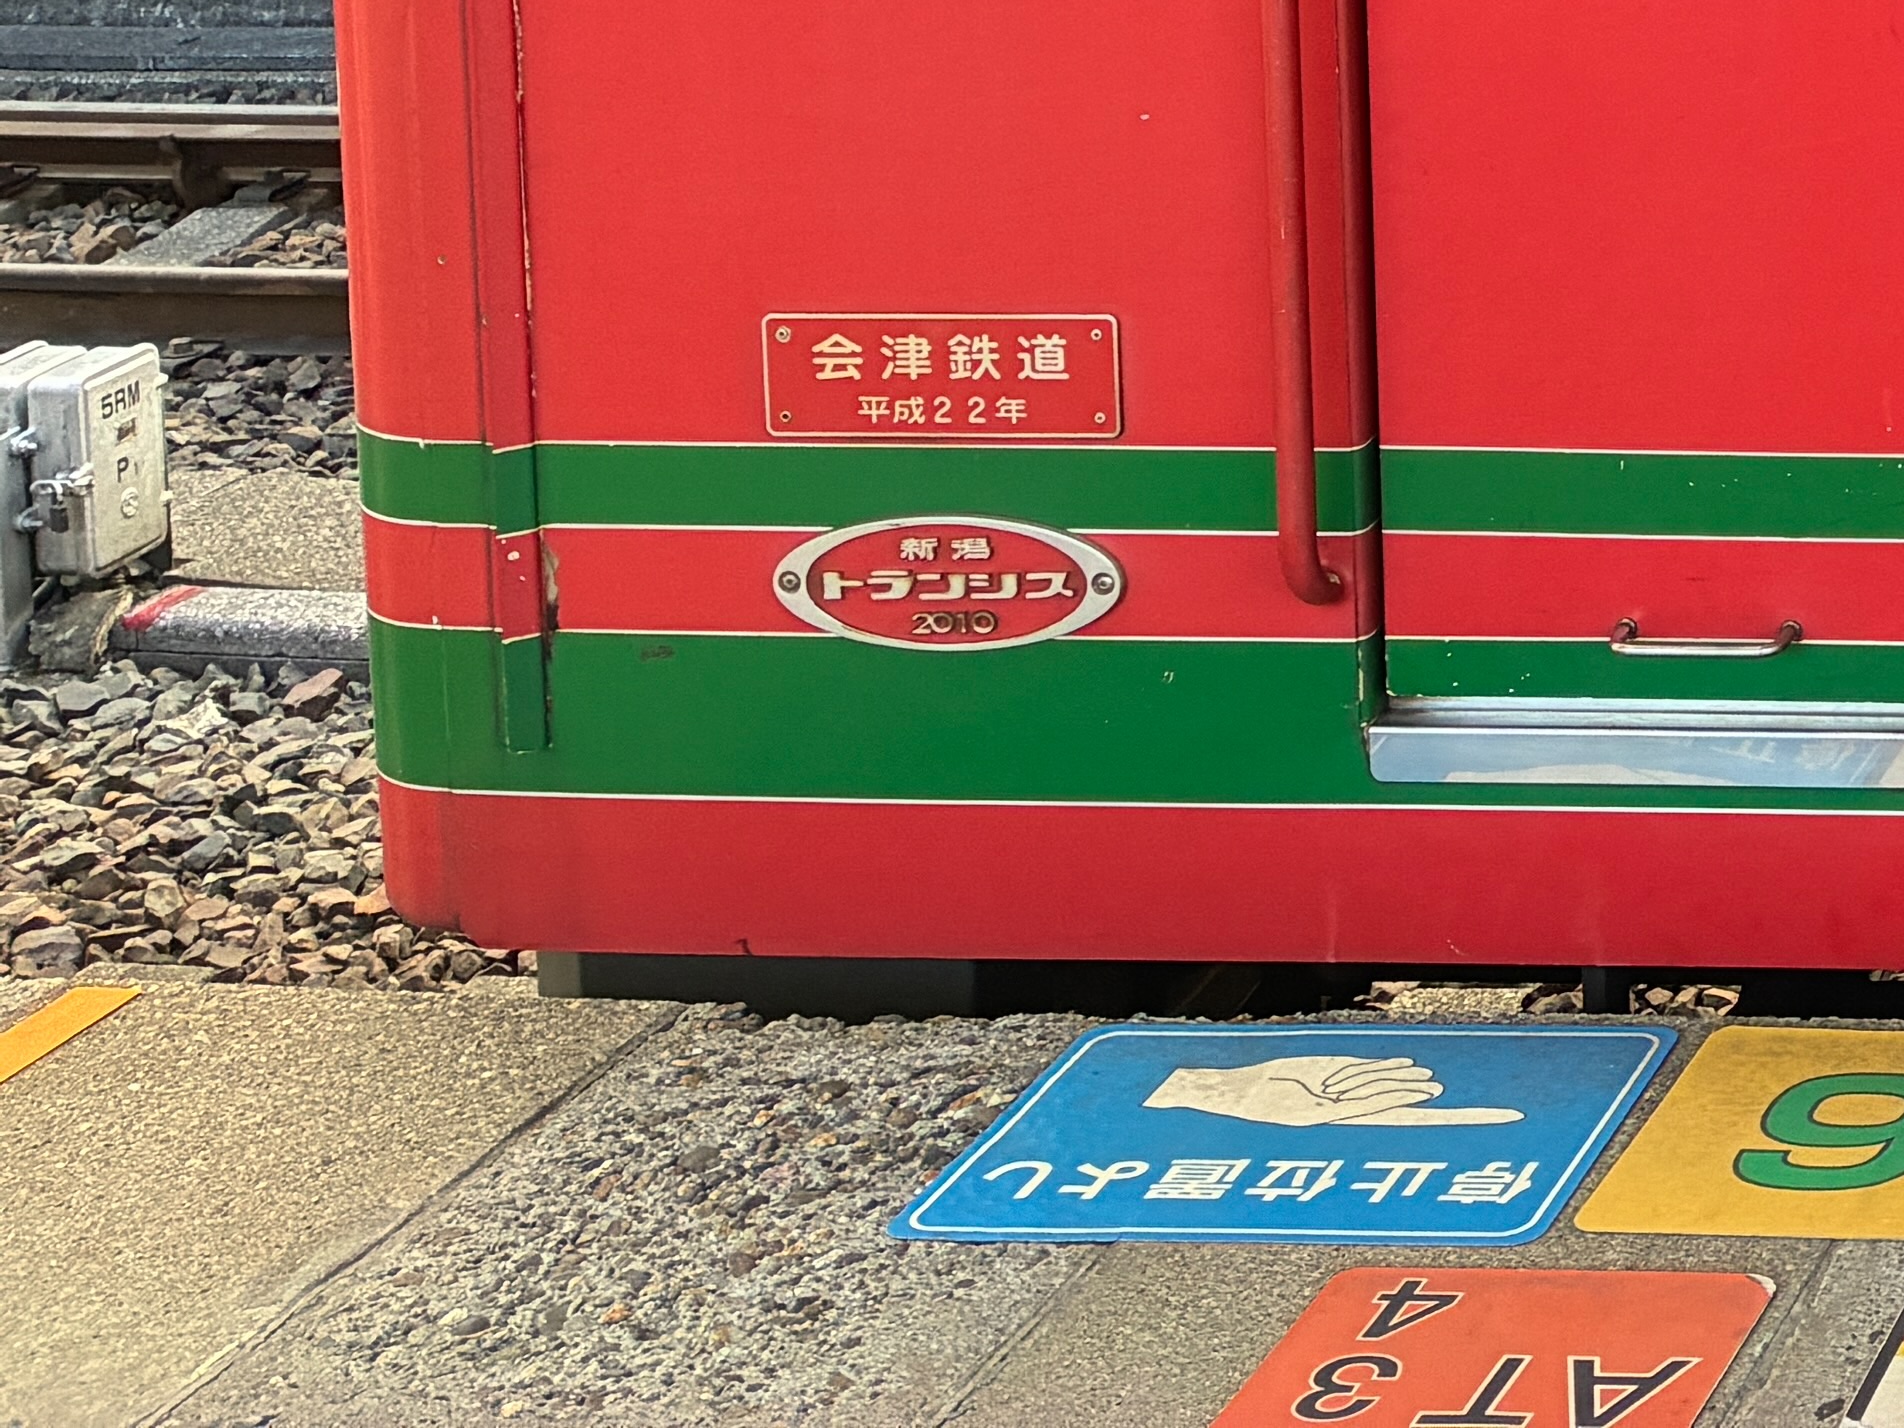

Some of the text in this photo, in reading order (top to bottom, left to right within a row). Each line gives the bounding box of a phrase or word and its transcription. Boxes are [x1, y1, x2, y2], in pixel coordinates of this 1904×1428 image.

[811, 332, 1071, 382] 会津鉄道
[857, 395, 1028, 425] 平成22年
[900, 536, 993, 562] 新潟
[822, 571, 1076, 601] トランシス
[911, 610, 998, 635] 2010
[982, 1157, 1535, 1205] 停止位置よし
